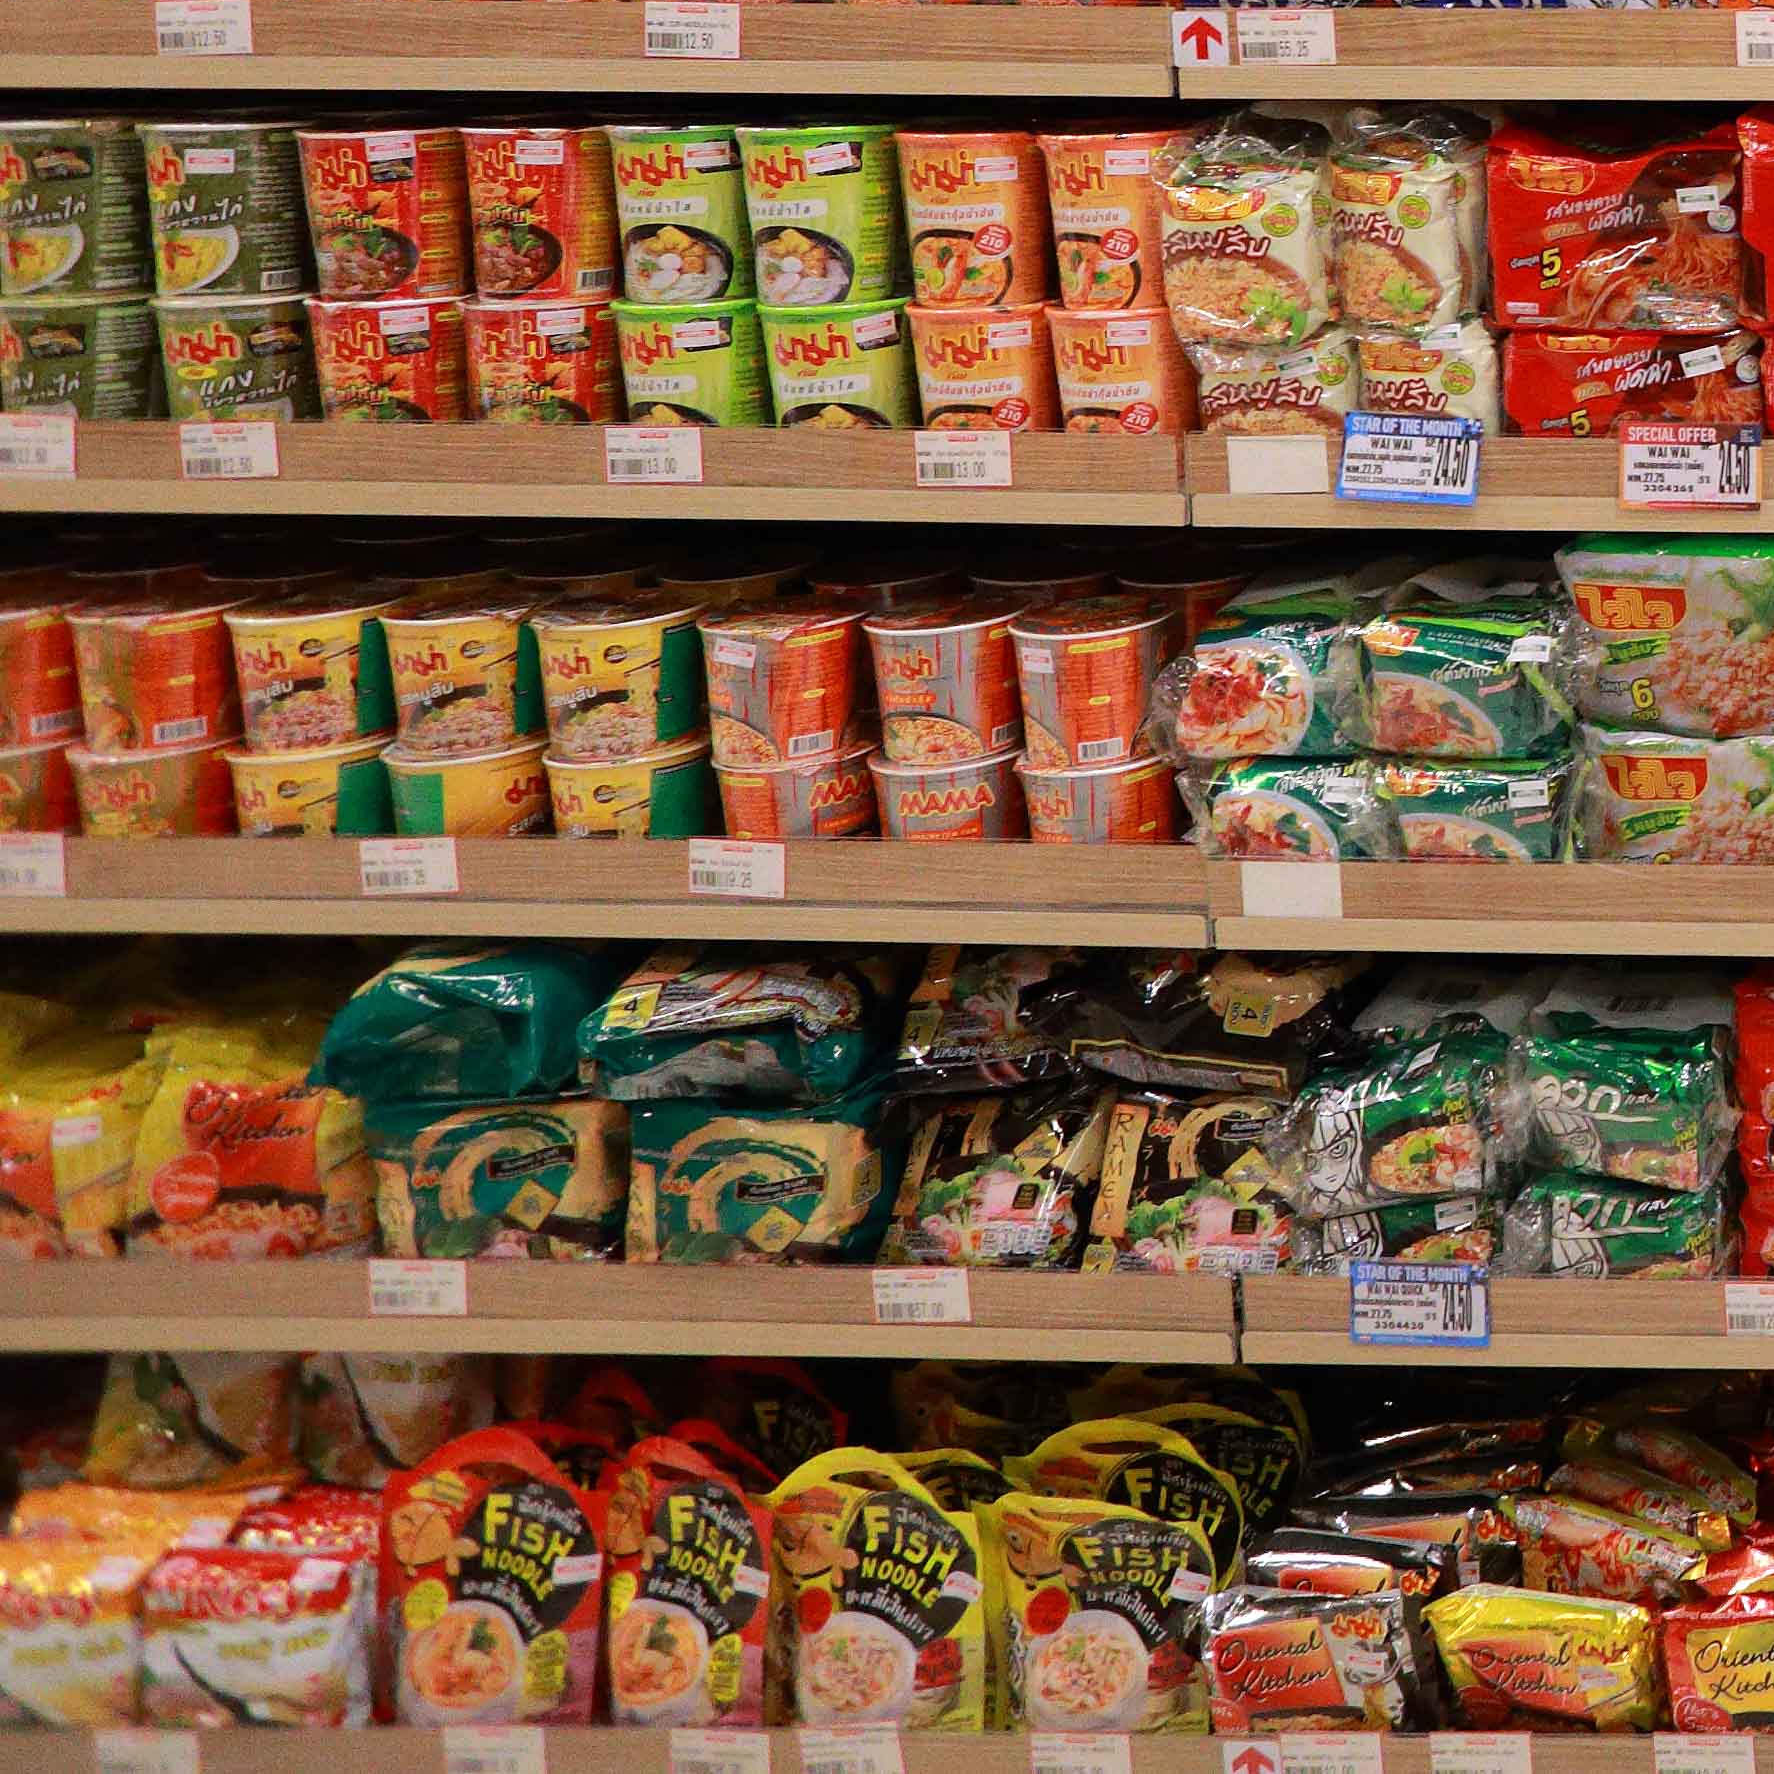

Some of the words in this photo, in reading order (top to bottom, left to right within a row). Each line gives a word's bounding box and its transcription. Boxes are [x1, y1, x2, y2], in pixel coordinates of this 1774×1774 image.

[1279, 40, 1309, 59] 55.25
[980, 234, 1004, 248] 210
[1107, 240, 1130, 254] 210
[1124, 411, 1151, 427] 210
[1352, 417, 1382, 431] STAR
[1382, 419, 1398, 433] OF
[1399, 419, 1421, 434] THE
[1422, 420, 1462, 437] MONTH
[1371, 438, 1390, 449] WAI
[1393, 439, 1412, 450] WAI
[1628, 427, 1676, 441] SPECIAL
[1678, 428, 1716, 442] OFFER
[1648, 447, 1667, 458] WAI
[1671, 447, 1690, 458] WAI
[646, 458, 677, 475] 13.00
[956, 460, 986, 478] 13.00
[900, 784, 995, 814] MAMA
[1358, 1266, 1387, 1280] STAR
[1388, 1266, 1404, 1280] OF
[1406, 1266, 1427, 1281] THE
[1428, 1267, 1467, 1281] MONTH
[484, 1493, 571, 1562] FISH
[865, 1502, 958, 1581] FISH
[1072, 1537, 1192, 1572] FISH
[482, 1548, 554, 1604] NOODLE
[861, 1557, 942, 1606] NOODLE
[1215, 1634, 1323, 1673] Oriental
[1470, 1644, 1573, 1673] Oriental
[1233, 1666, 1332, 1701] Kitchen
